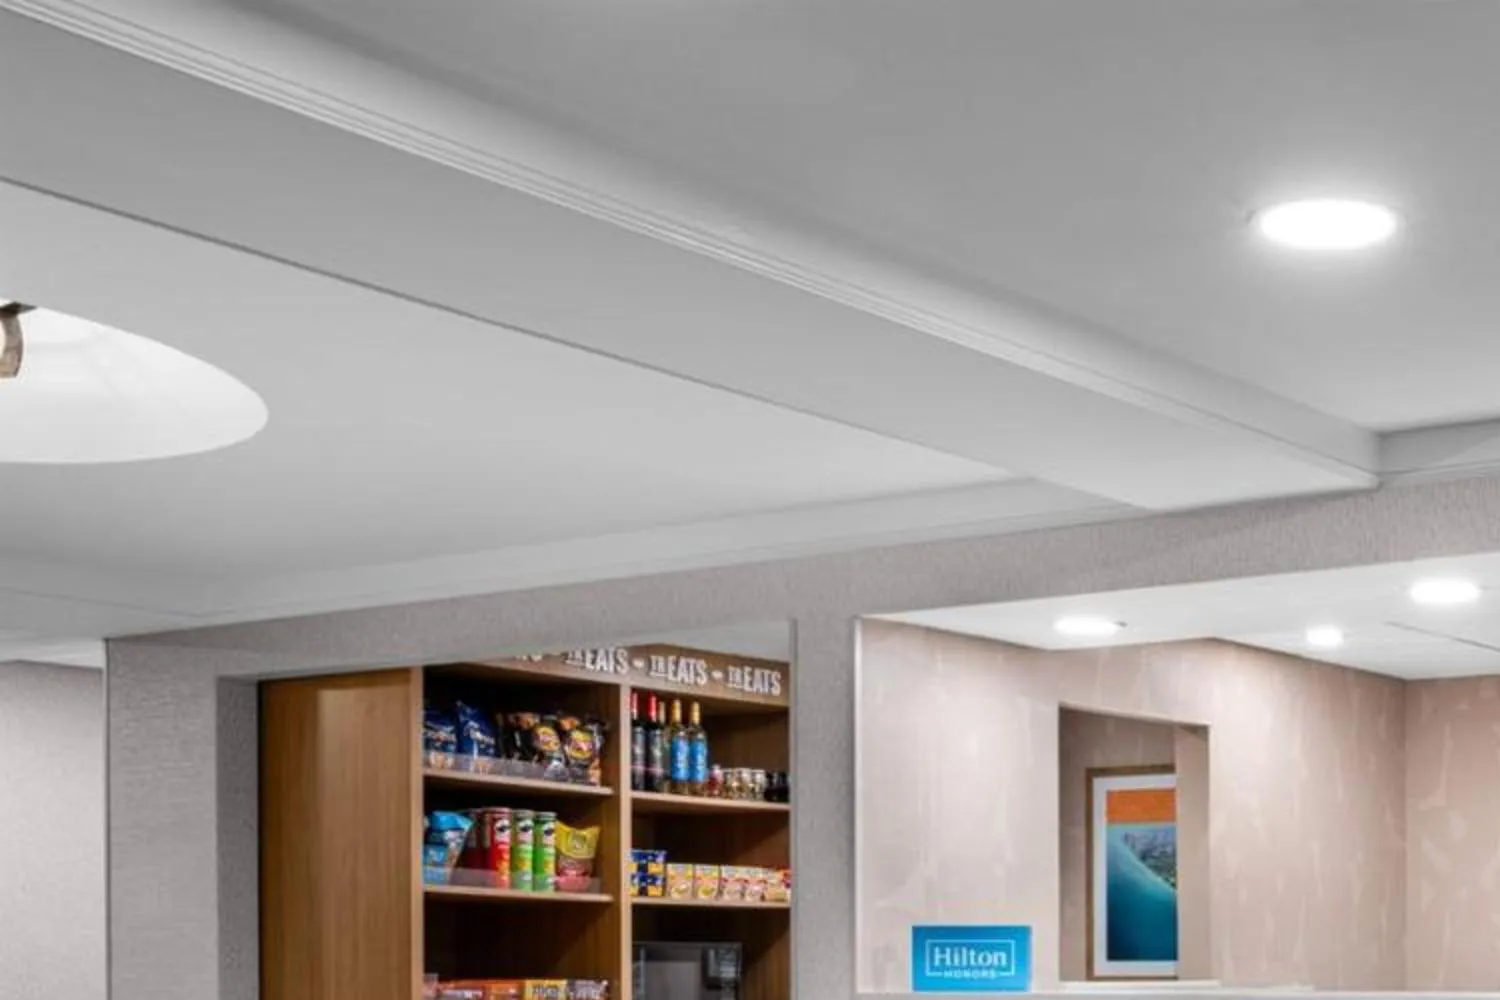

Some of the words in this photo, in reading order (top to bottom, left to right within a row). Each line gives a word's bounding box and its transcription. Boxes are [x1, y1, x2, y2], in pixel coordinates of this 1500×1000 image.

[650, 656, 707, 686] TREATS
[727, 666, 781, 697] TREATS
[933, 946, 1007, 967] Hilton
